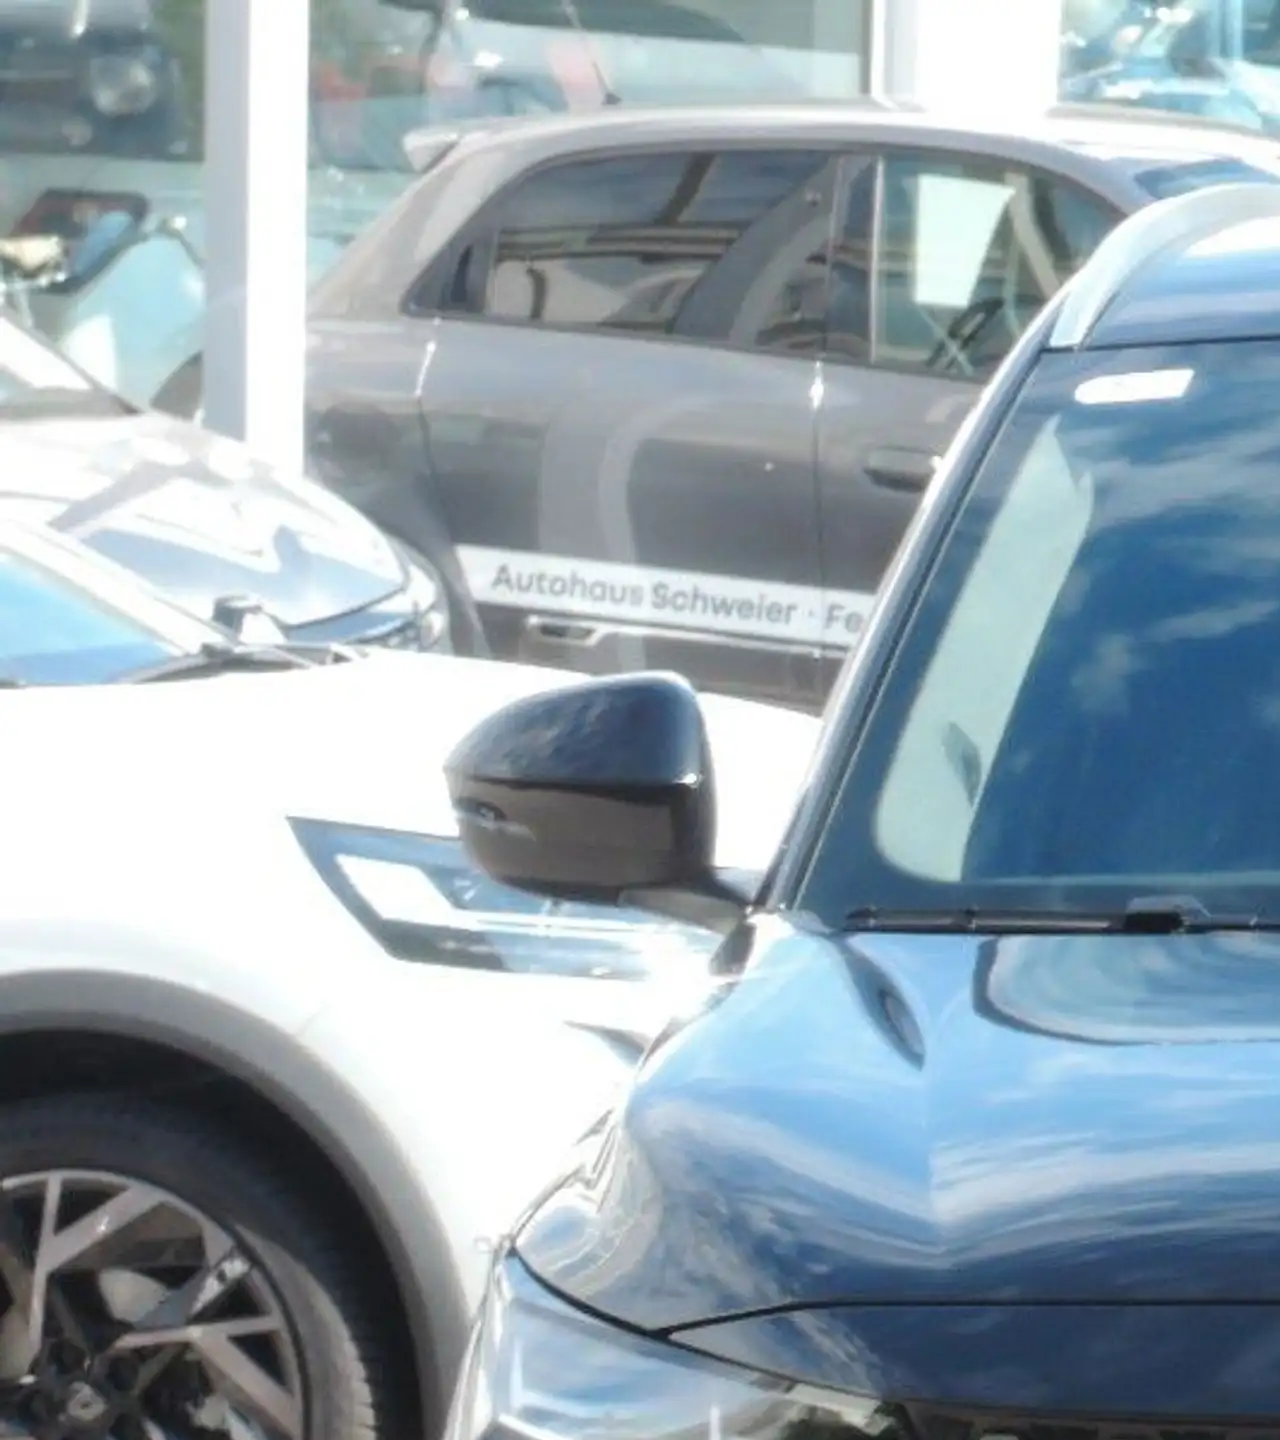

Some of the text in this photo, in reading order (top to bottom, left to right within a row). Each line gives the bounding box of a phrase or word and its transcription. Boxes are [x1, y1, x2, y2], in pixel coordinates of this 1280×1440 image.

[491, 563, 866, 633] Autohaus Schweier Fe
